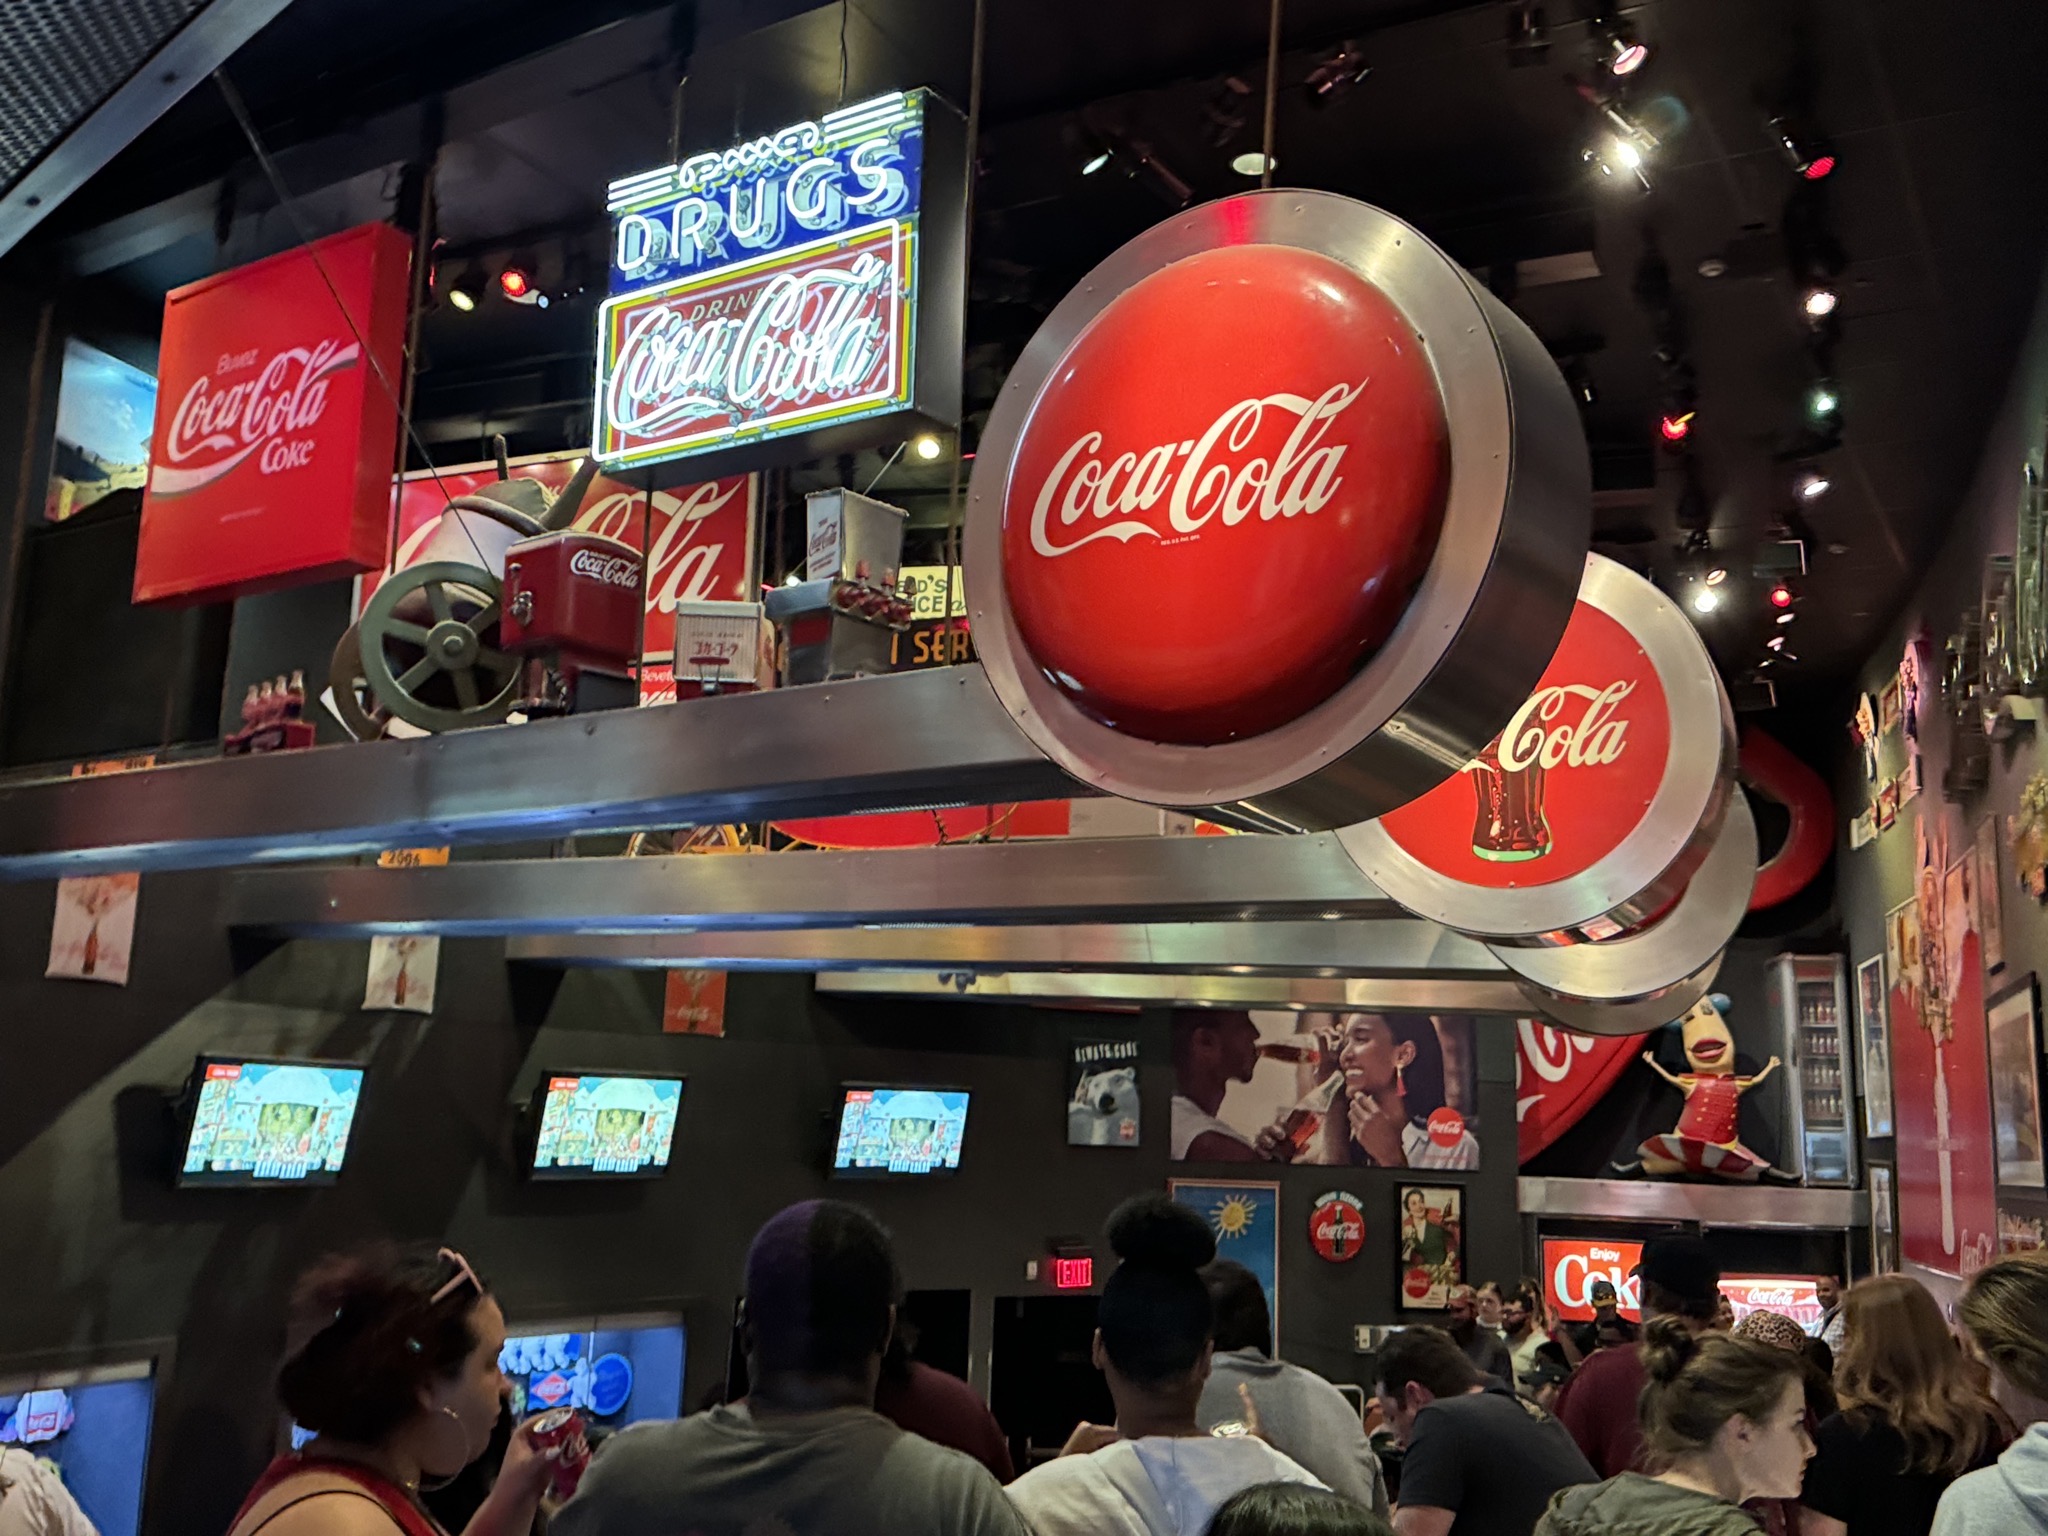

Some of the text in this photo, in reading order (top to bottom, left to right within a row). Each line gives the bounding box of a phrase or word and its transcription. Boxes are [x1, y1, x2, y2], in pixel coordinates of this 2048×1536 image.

[617, 138, 907, 280] DRUGS
[606, 252, 902, 433] Coca-Cola
[167, 340, 340, 463] Coca-Cola
[260, 437, 315, 475] Coke
[1030, 376, 1370, 557] Coca-Cola
[570, 549, 642, 589] Coca-Cola
[1063, 1260, 1088, 1284] EXIT
[1554, 1254, 1641, 1309] Cok
[1590, 1247, 1621, 1262] Enjoy
